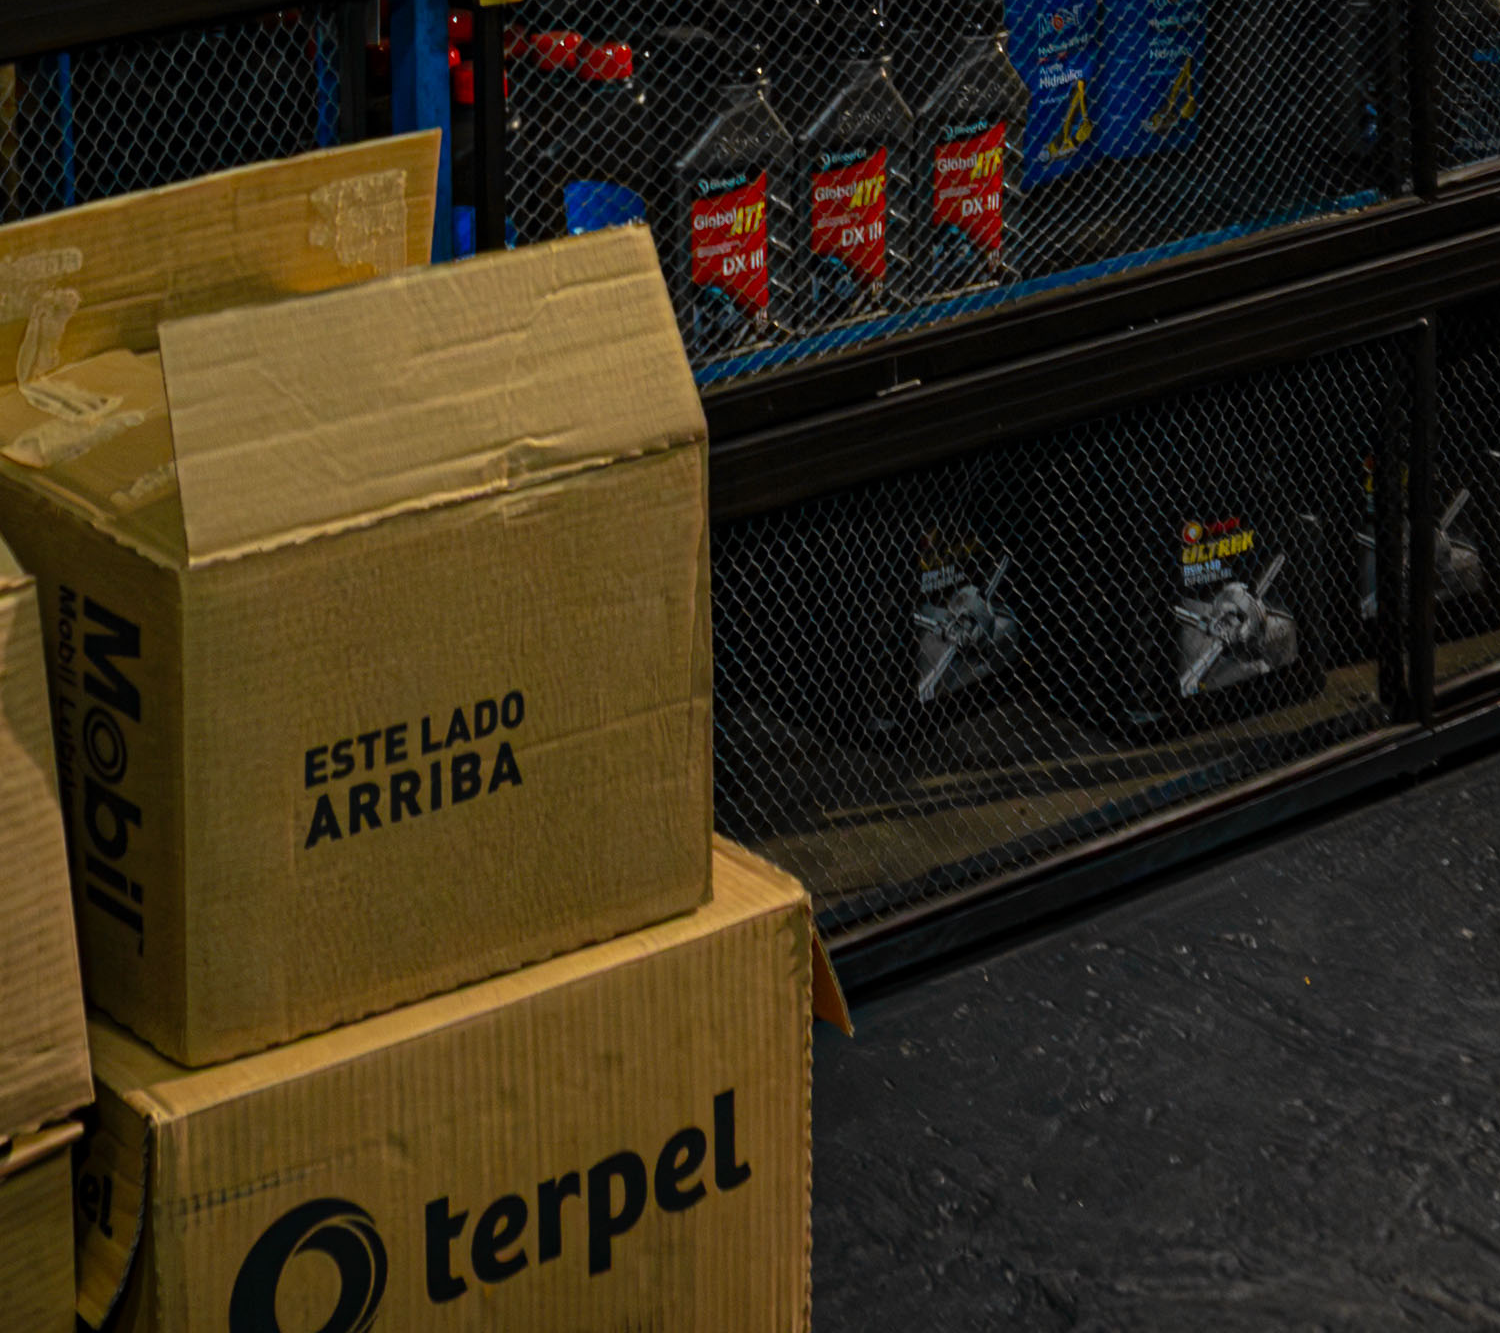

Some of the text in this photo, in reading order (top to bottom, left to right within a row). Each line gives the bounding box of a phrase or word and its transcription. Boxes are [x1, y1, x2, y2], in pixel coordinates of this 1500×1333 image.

[935, 146, 1004, 181] Global ATF
[813, 174, 886, 210] Global ATF
[960, 196, 984, 218] DX
[692, 201, 766, 237] Global ATF
[841, 226, 865, 248] DX
[722, 255, 746, 276] DX
[56, 584, 78, 687] Mobil
[304, 688, 526, 791] ESTE LADO
[82, 595, 143, 933] Mobil
[304, 741, 525, 851] ARRIBA
[425, 1088, 752, 1305] terpel
